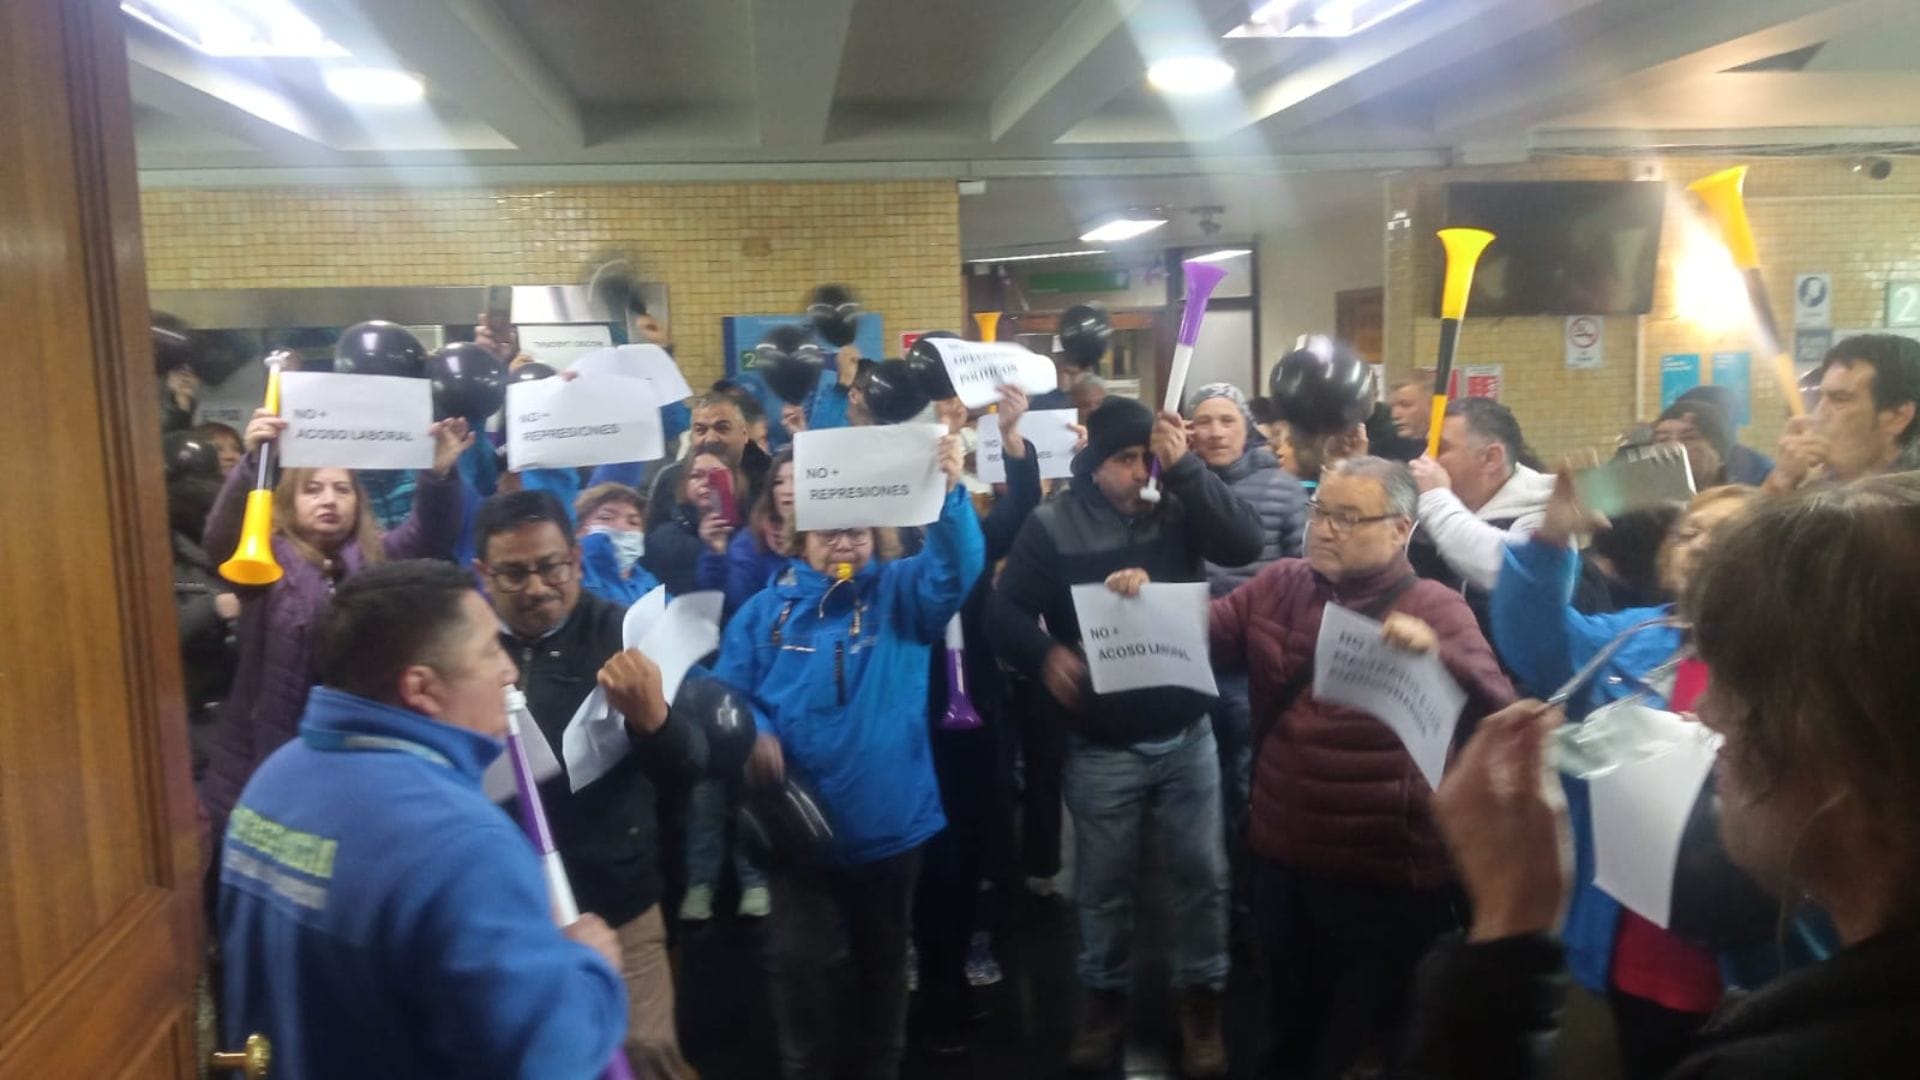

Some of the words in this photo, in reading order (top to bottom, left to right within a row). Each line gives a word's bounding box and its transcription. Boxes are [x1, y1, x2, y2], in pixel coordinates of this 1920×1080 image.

[1894, 286, 1918, 323] 2
[294, 408, 317, 420] NO
[296, 428, 348, 441] ACOSO
[351, 429, 414, 442] LABORAL
[523, 423, 621, 441] REPRESIONES
[806, 467, 829, 480] NO
[809, 484, 910, 501] REPRESIONES
[1090, 627, 1110, 640] NO
[1099, 642, 1147, 661] ACOSO
